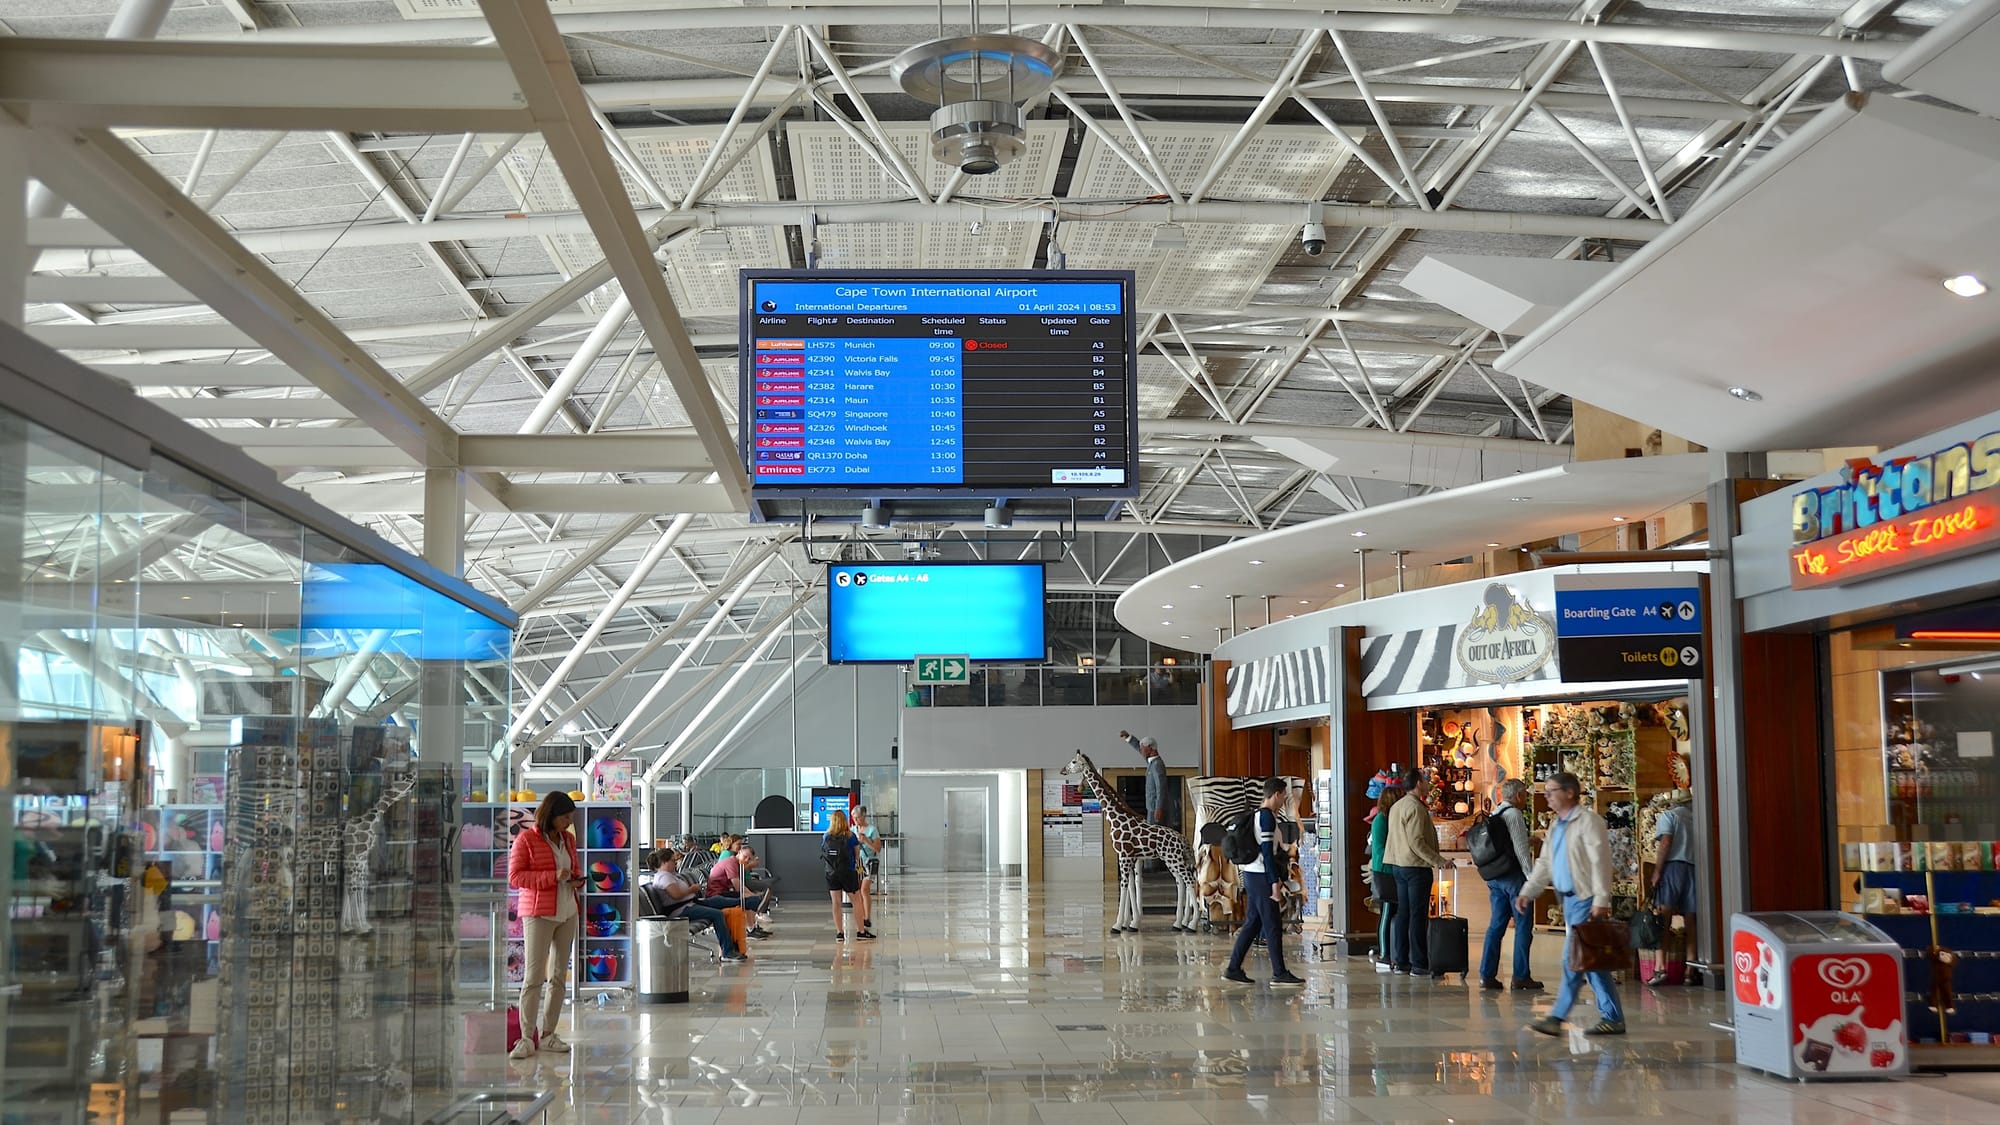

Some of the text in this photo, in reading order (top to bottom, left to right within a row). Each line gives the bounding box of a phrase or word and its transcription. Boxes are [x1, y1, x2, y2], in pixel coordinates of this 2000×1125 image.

[834, 287, 1038, 299] Cape Town International Airport
[794, 303, 908, 312] International Departures
[1018, 303, 1030, 311] 01
[1032, 303, 1055, 312] April
[1056, 303, 1080, 311] 2024
[1089, 303, 1116, 311] 08:53
[759, 316, 787, 325] Airline
[807, 316, 838, 326] Flight#
[846, 316, 895, 325] Destination
[921, 317, 965, 325] Scheduled
[979, 317, 1007, 325] Status
[1040, 317, 1077, 326] Updated
[1089, 317, 1110, 325] Gate
[934, 328, 953, 336] time
[1050, 328, 1069, 336] time
[875, 369, 891, 377] Bay
[845, 411, 888, 419] Singapore
[875, 439, 891, 447] Bay
[1792, 431, 2000, 545] Brittans
[1793, 549, 1829, 575] The
[869, 574, 895, 583] Gates
[896, 574, 909, 582] A4
[1564, 606, 1657, 620] Boarding Gate A4
[1469, 636, 1537, 661] OUT OF AFRICA
[1621, 651, 1658, 663] Toilets
[1739, 975, 1750, 983] OLA
[1830, 991, 1861, 1004] OLA
